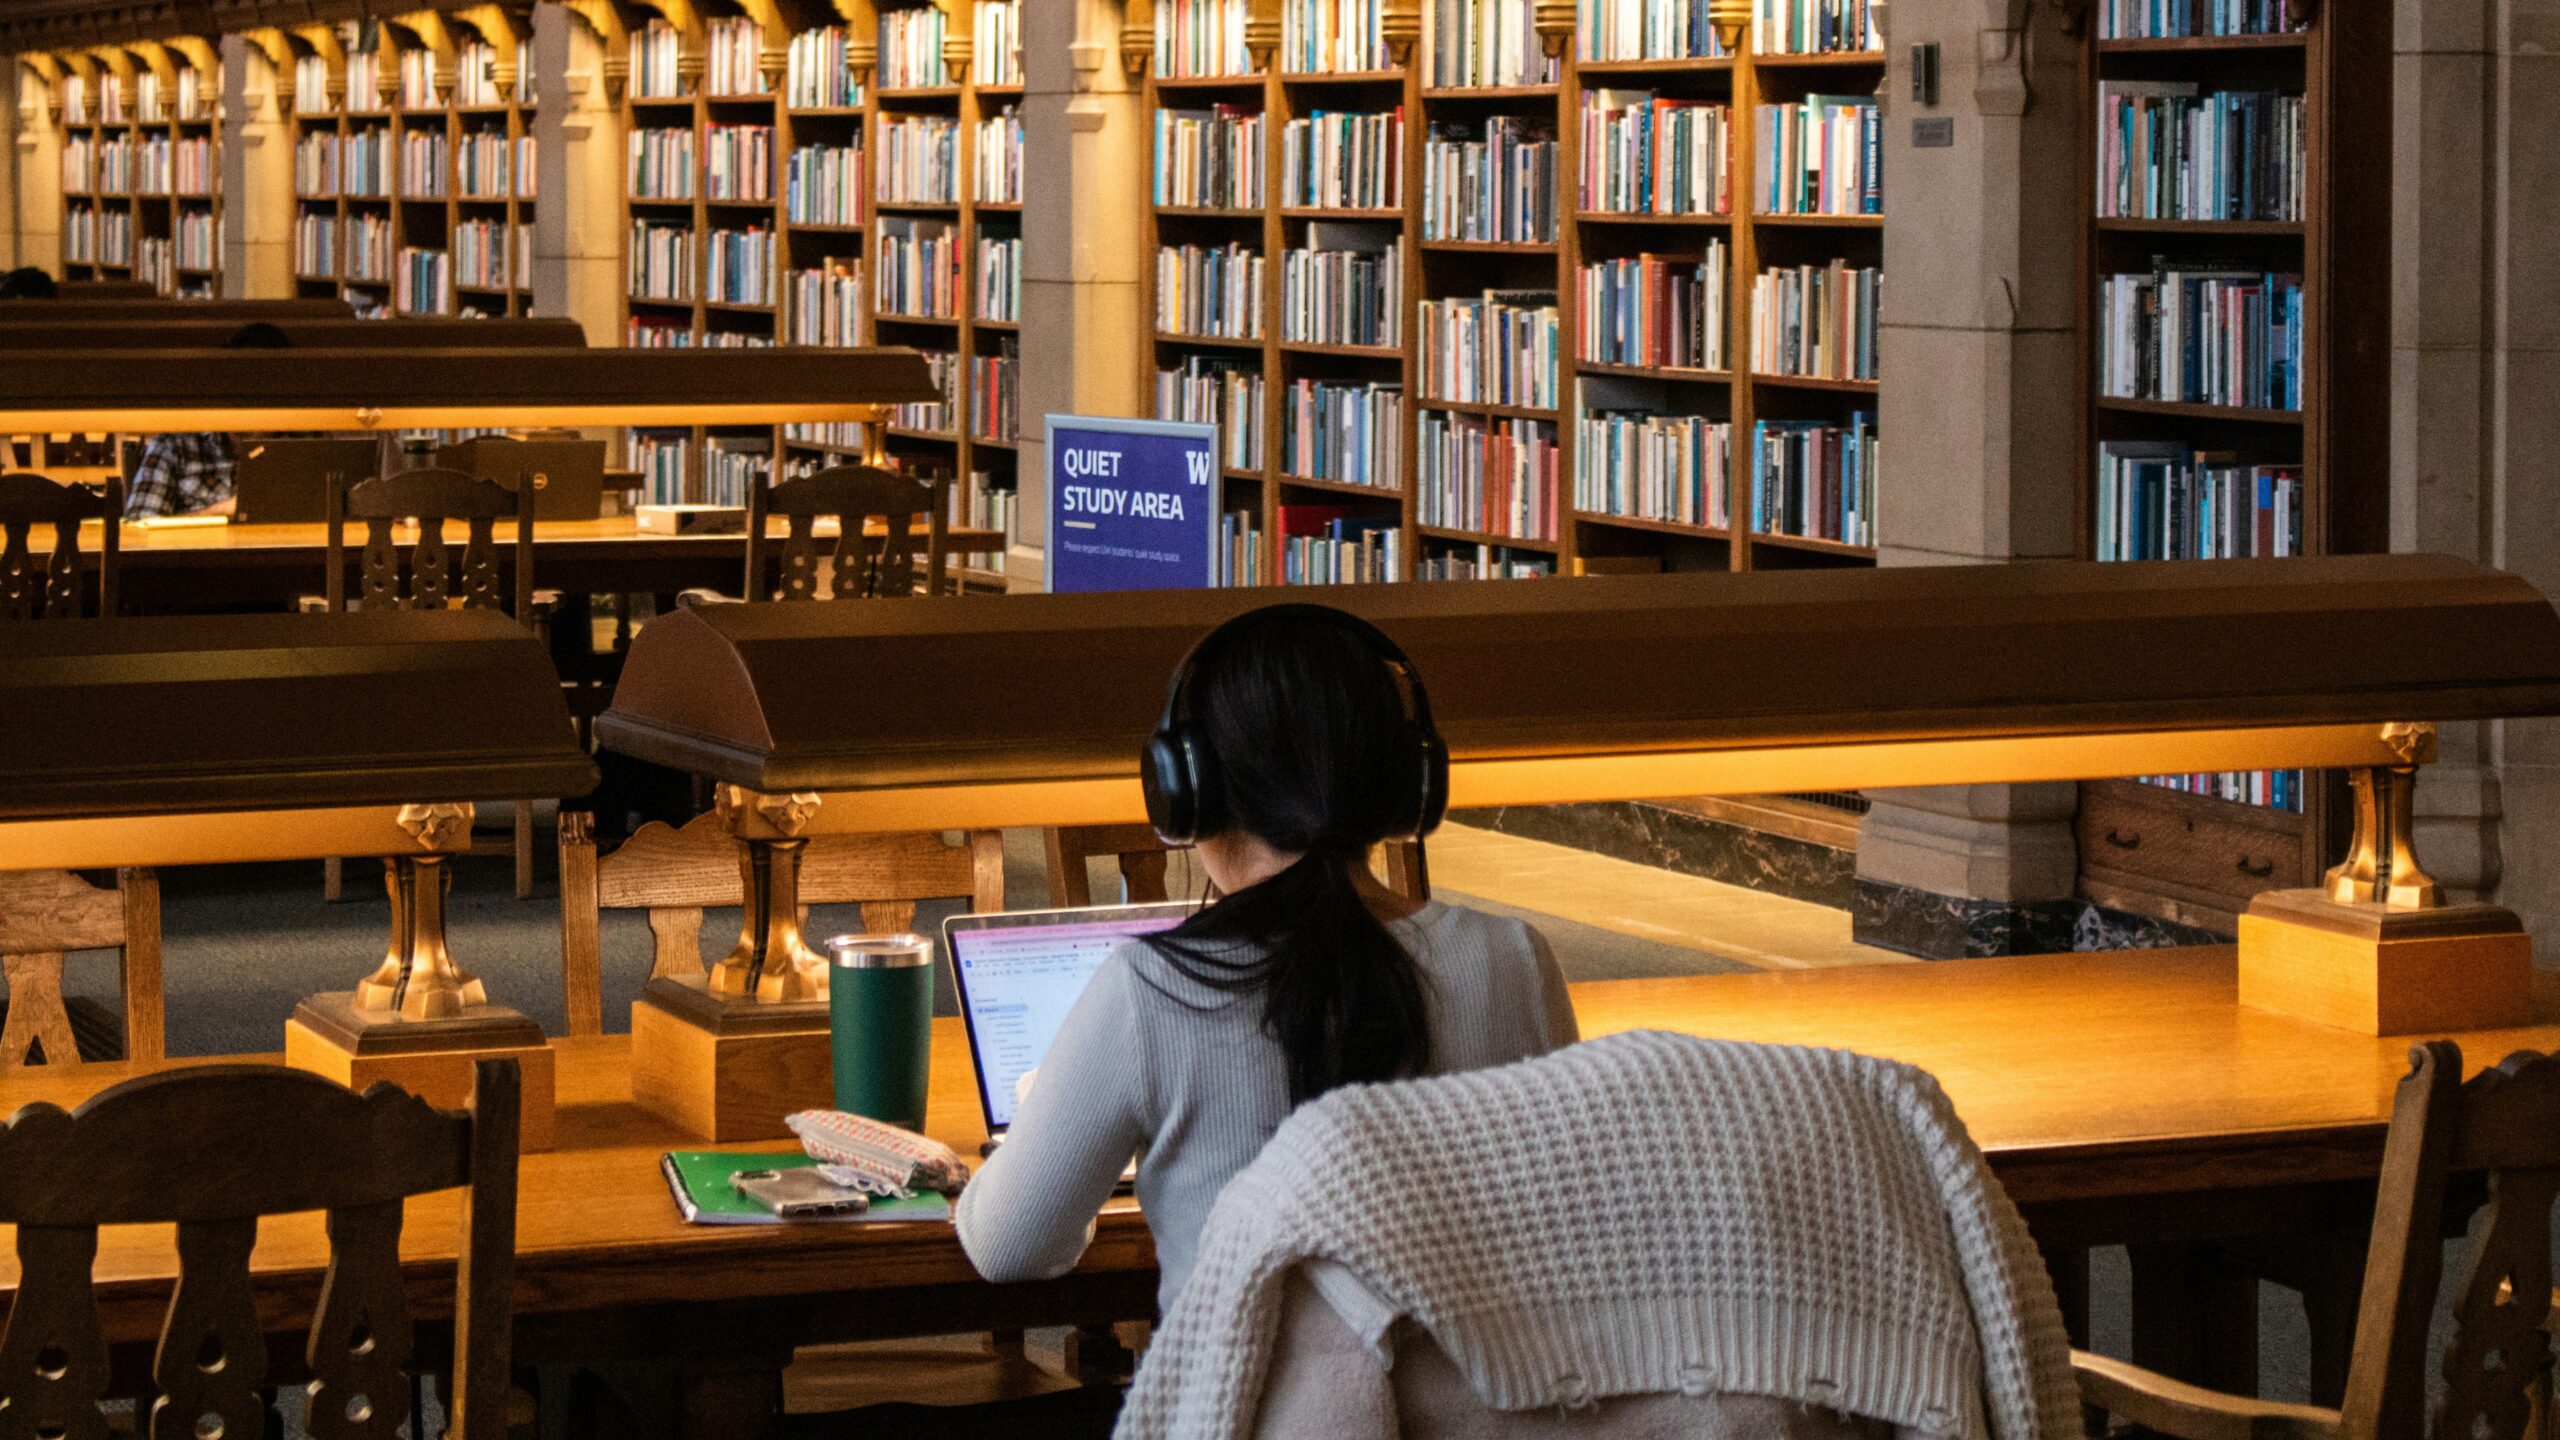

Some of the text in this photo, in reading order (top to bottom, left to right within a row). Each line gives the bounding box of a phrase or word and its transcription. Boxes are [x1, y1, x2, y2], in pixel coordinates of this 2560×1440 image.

[1064, 448, 1122, 478] QUIET
[1186, 451, 1209, 485] W
[1064, 485, 1184, 521] STUDY AREA
